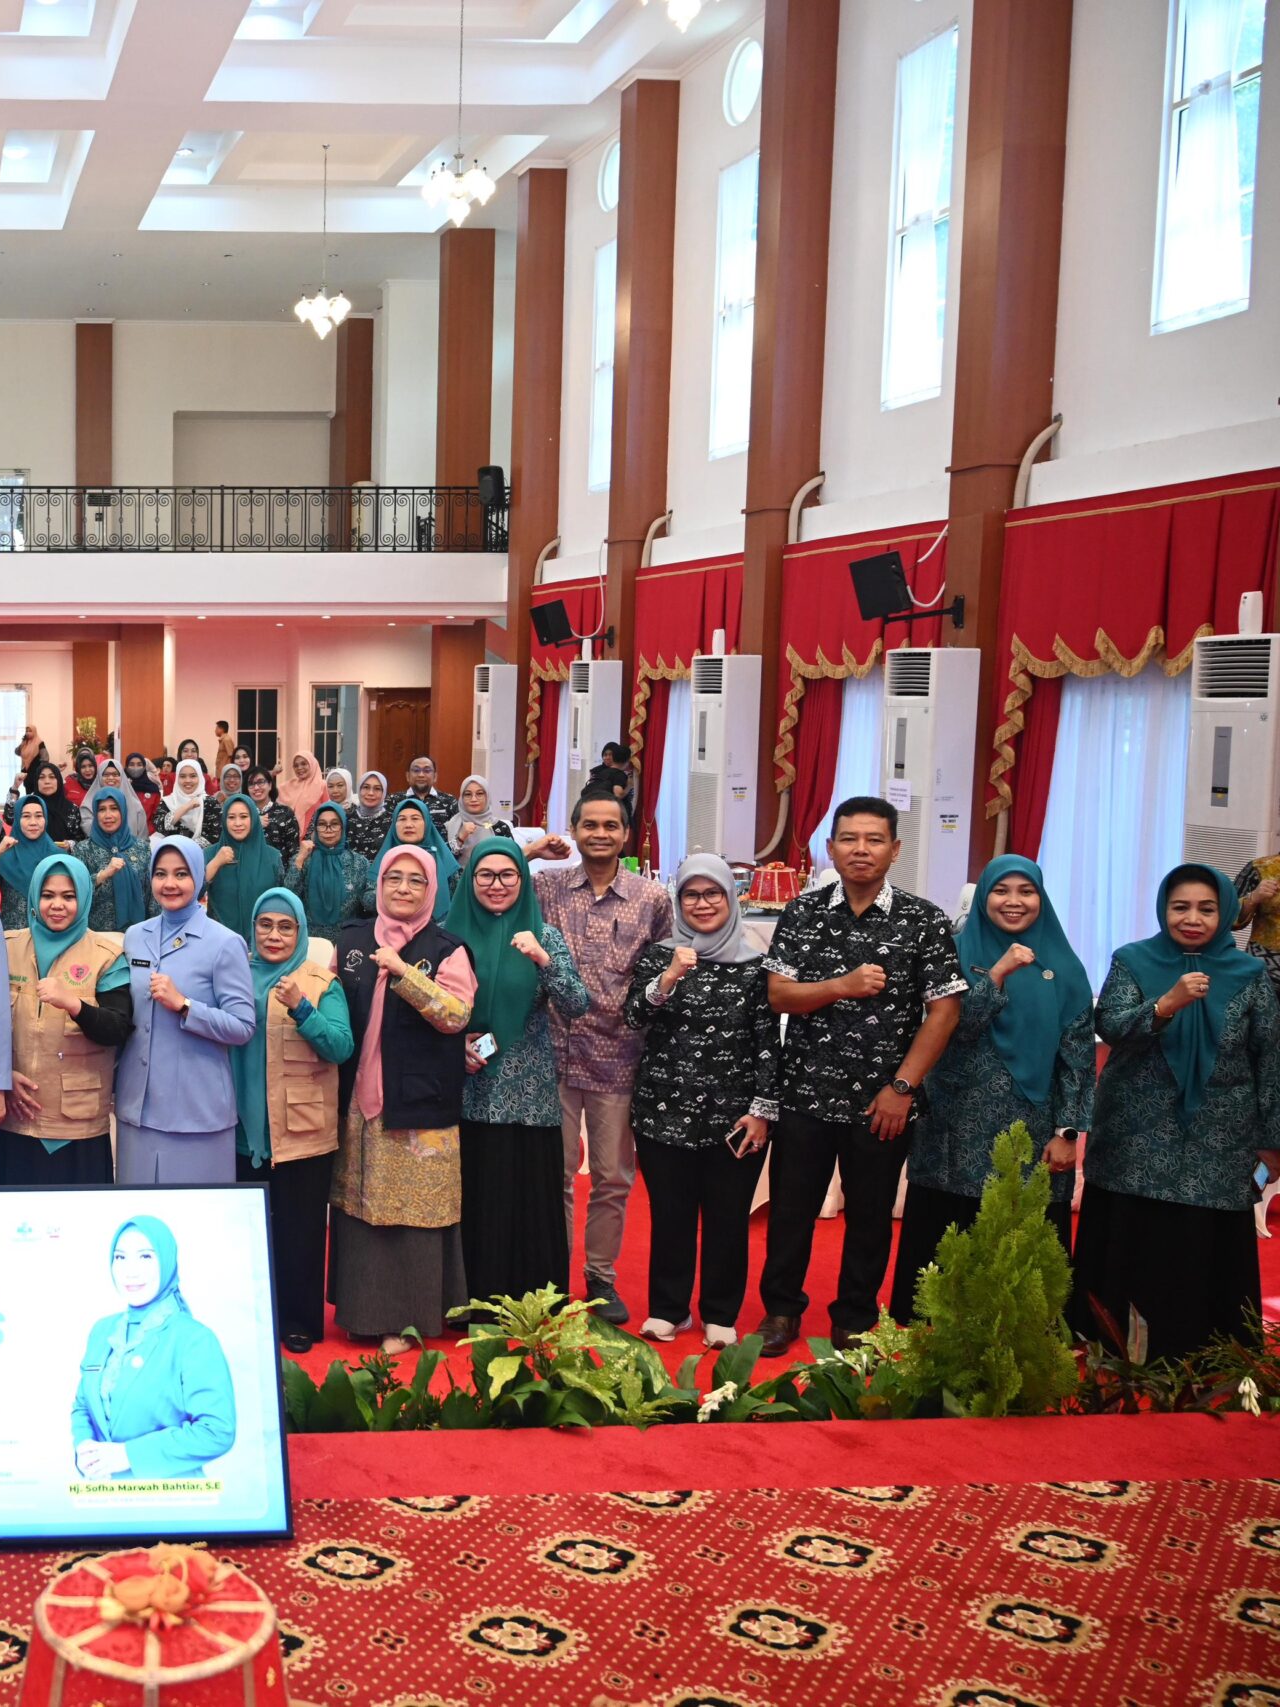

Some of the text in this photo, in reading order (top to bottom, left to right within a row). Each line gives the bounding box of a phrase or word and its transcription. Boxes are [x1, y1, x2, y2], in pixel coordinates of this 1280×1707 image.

[69, 1481, 220, 1494] Hj. Sofha Marwah Bahtiar, S.E
